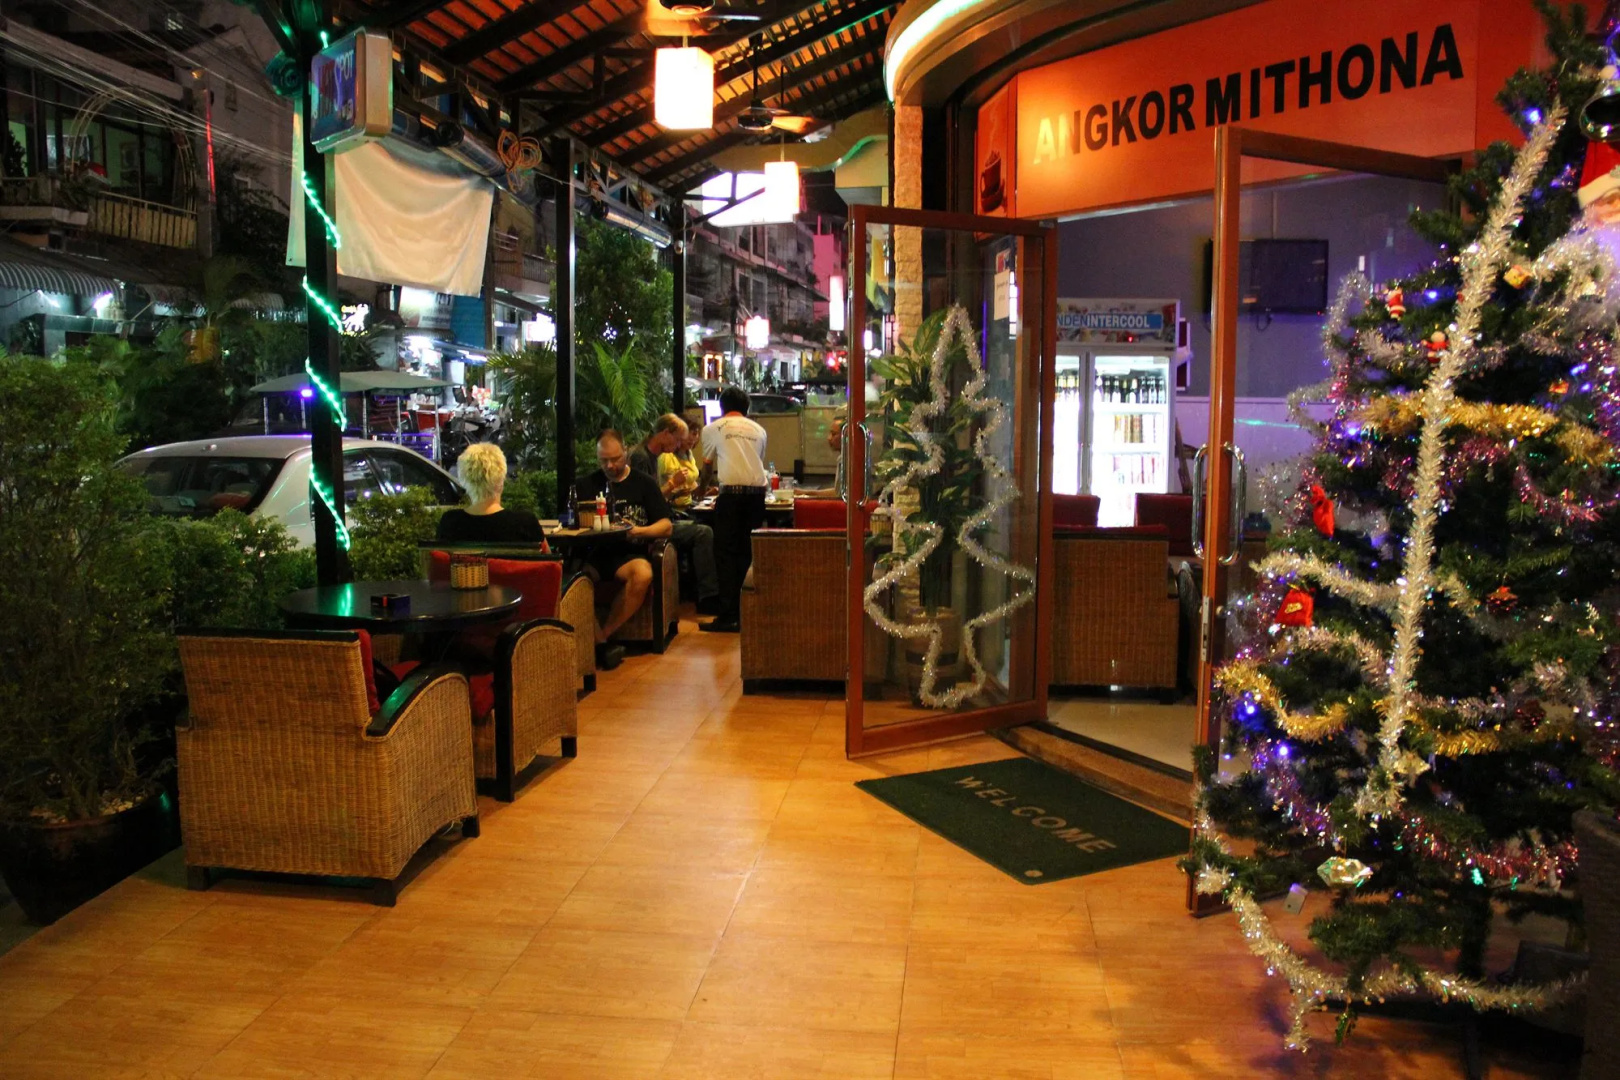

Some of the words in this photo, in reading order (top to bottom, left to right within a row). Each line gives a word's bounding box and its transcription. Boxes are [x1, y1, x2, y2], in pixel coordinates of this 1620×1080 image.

[1034, 83, 1195, 164] ANGKOR
[1205, 25, 1464, 127] MITHONA
[955, 776, 1117, 854] WELCOME
